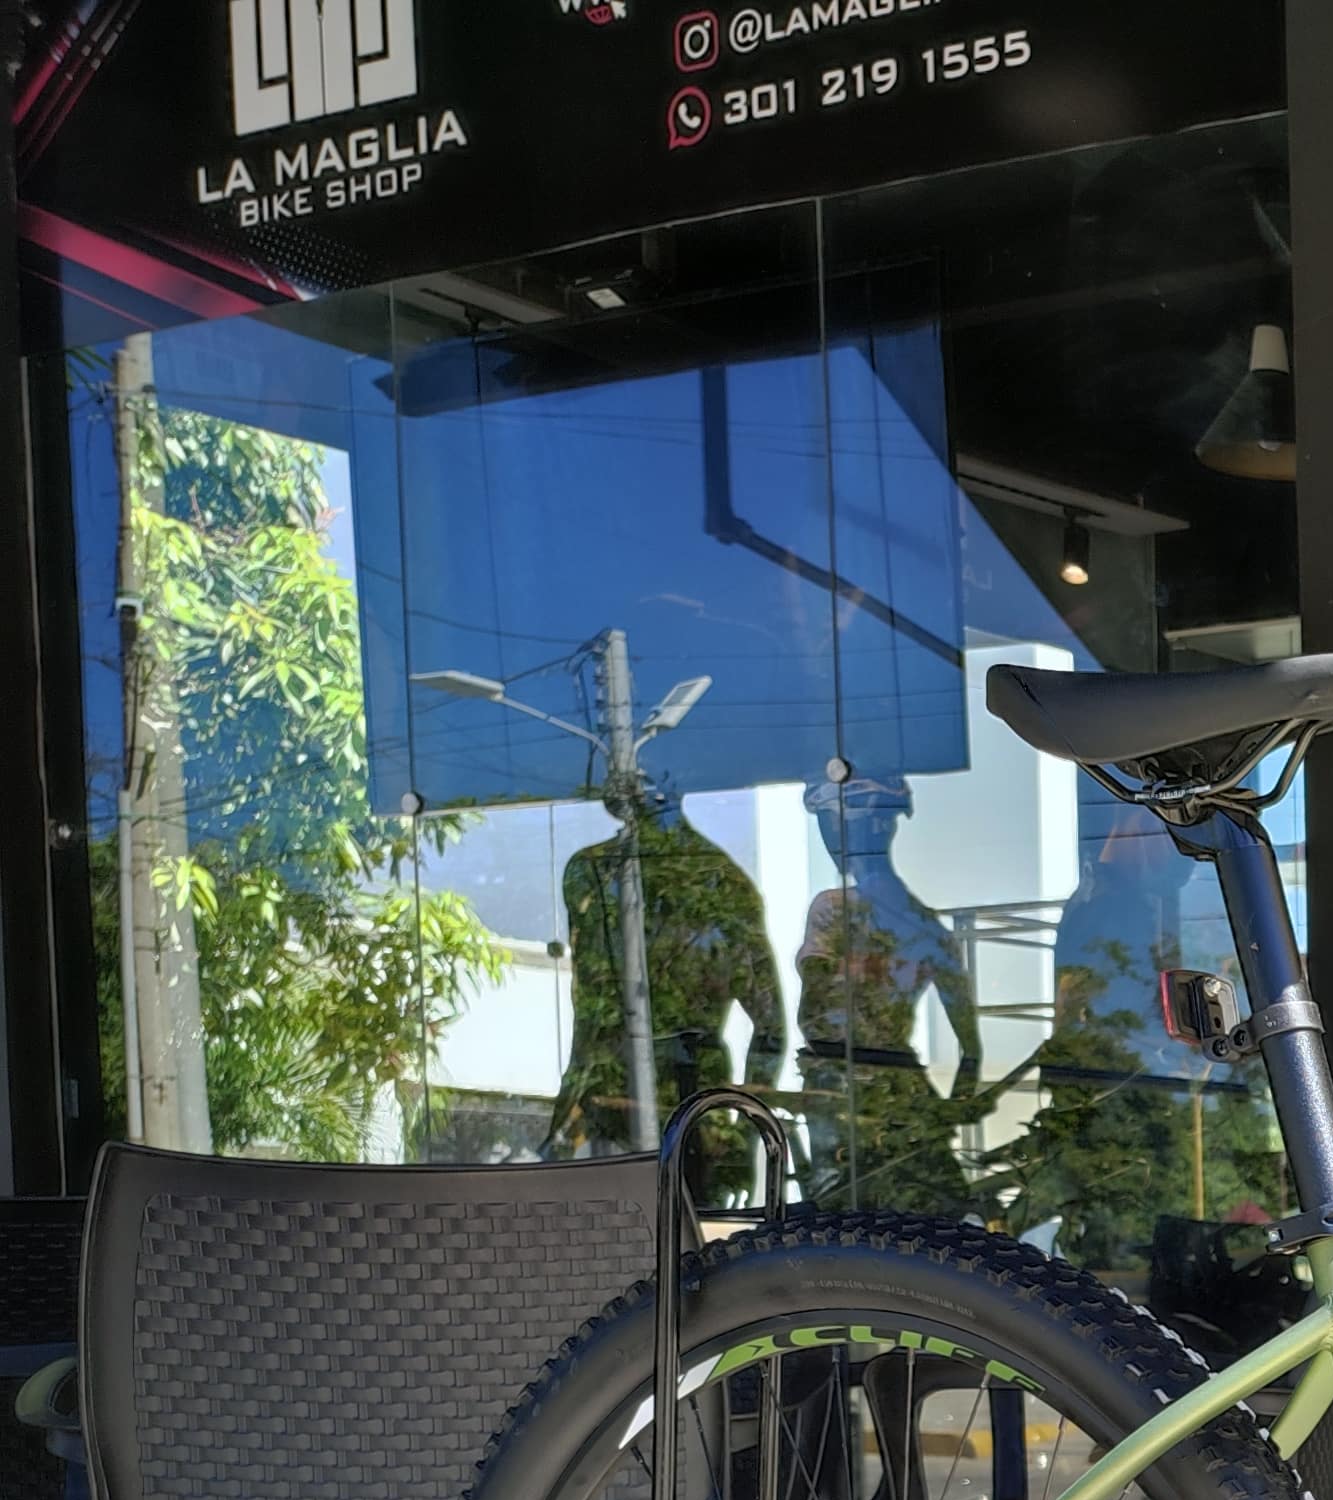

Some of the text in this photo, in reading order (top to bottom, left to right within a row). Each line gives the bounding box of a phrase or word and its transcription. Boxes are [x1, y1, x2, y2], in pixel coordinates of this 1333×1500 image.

[723, 29, 1032, 125] 301 219 1555
[197, 109, 468, 203] LA MAGLIA
[239, 162, 422, 228] BIKE SHOP
[790, 1326, 1047, 1391] CLIFF
